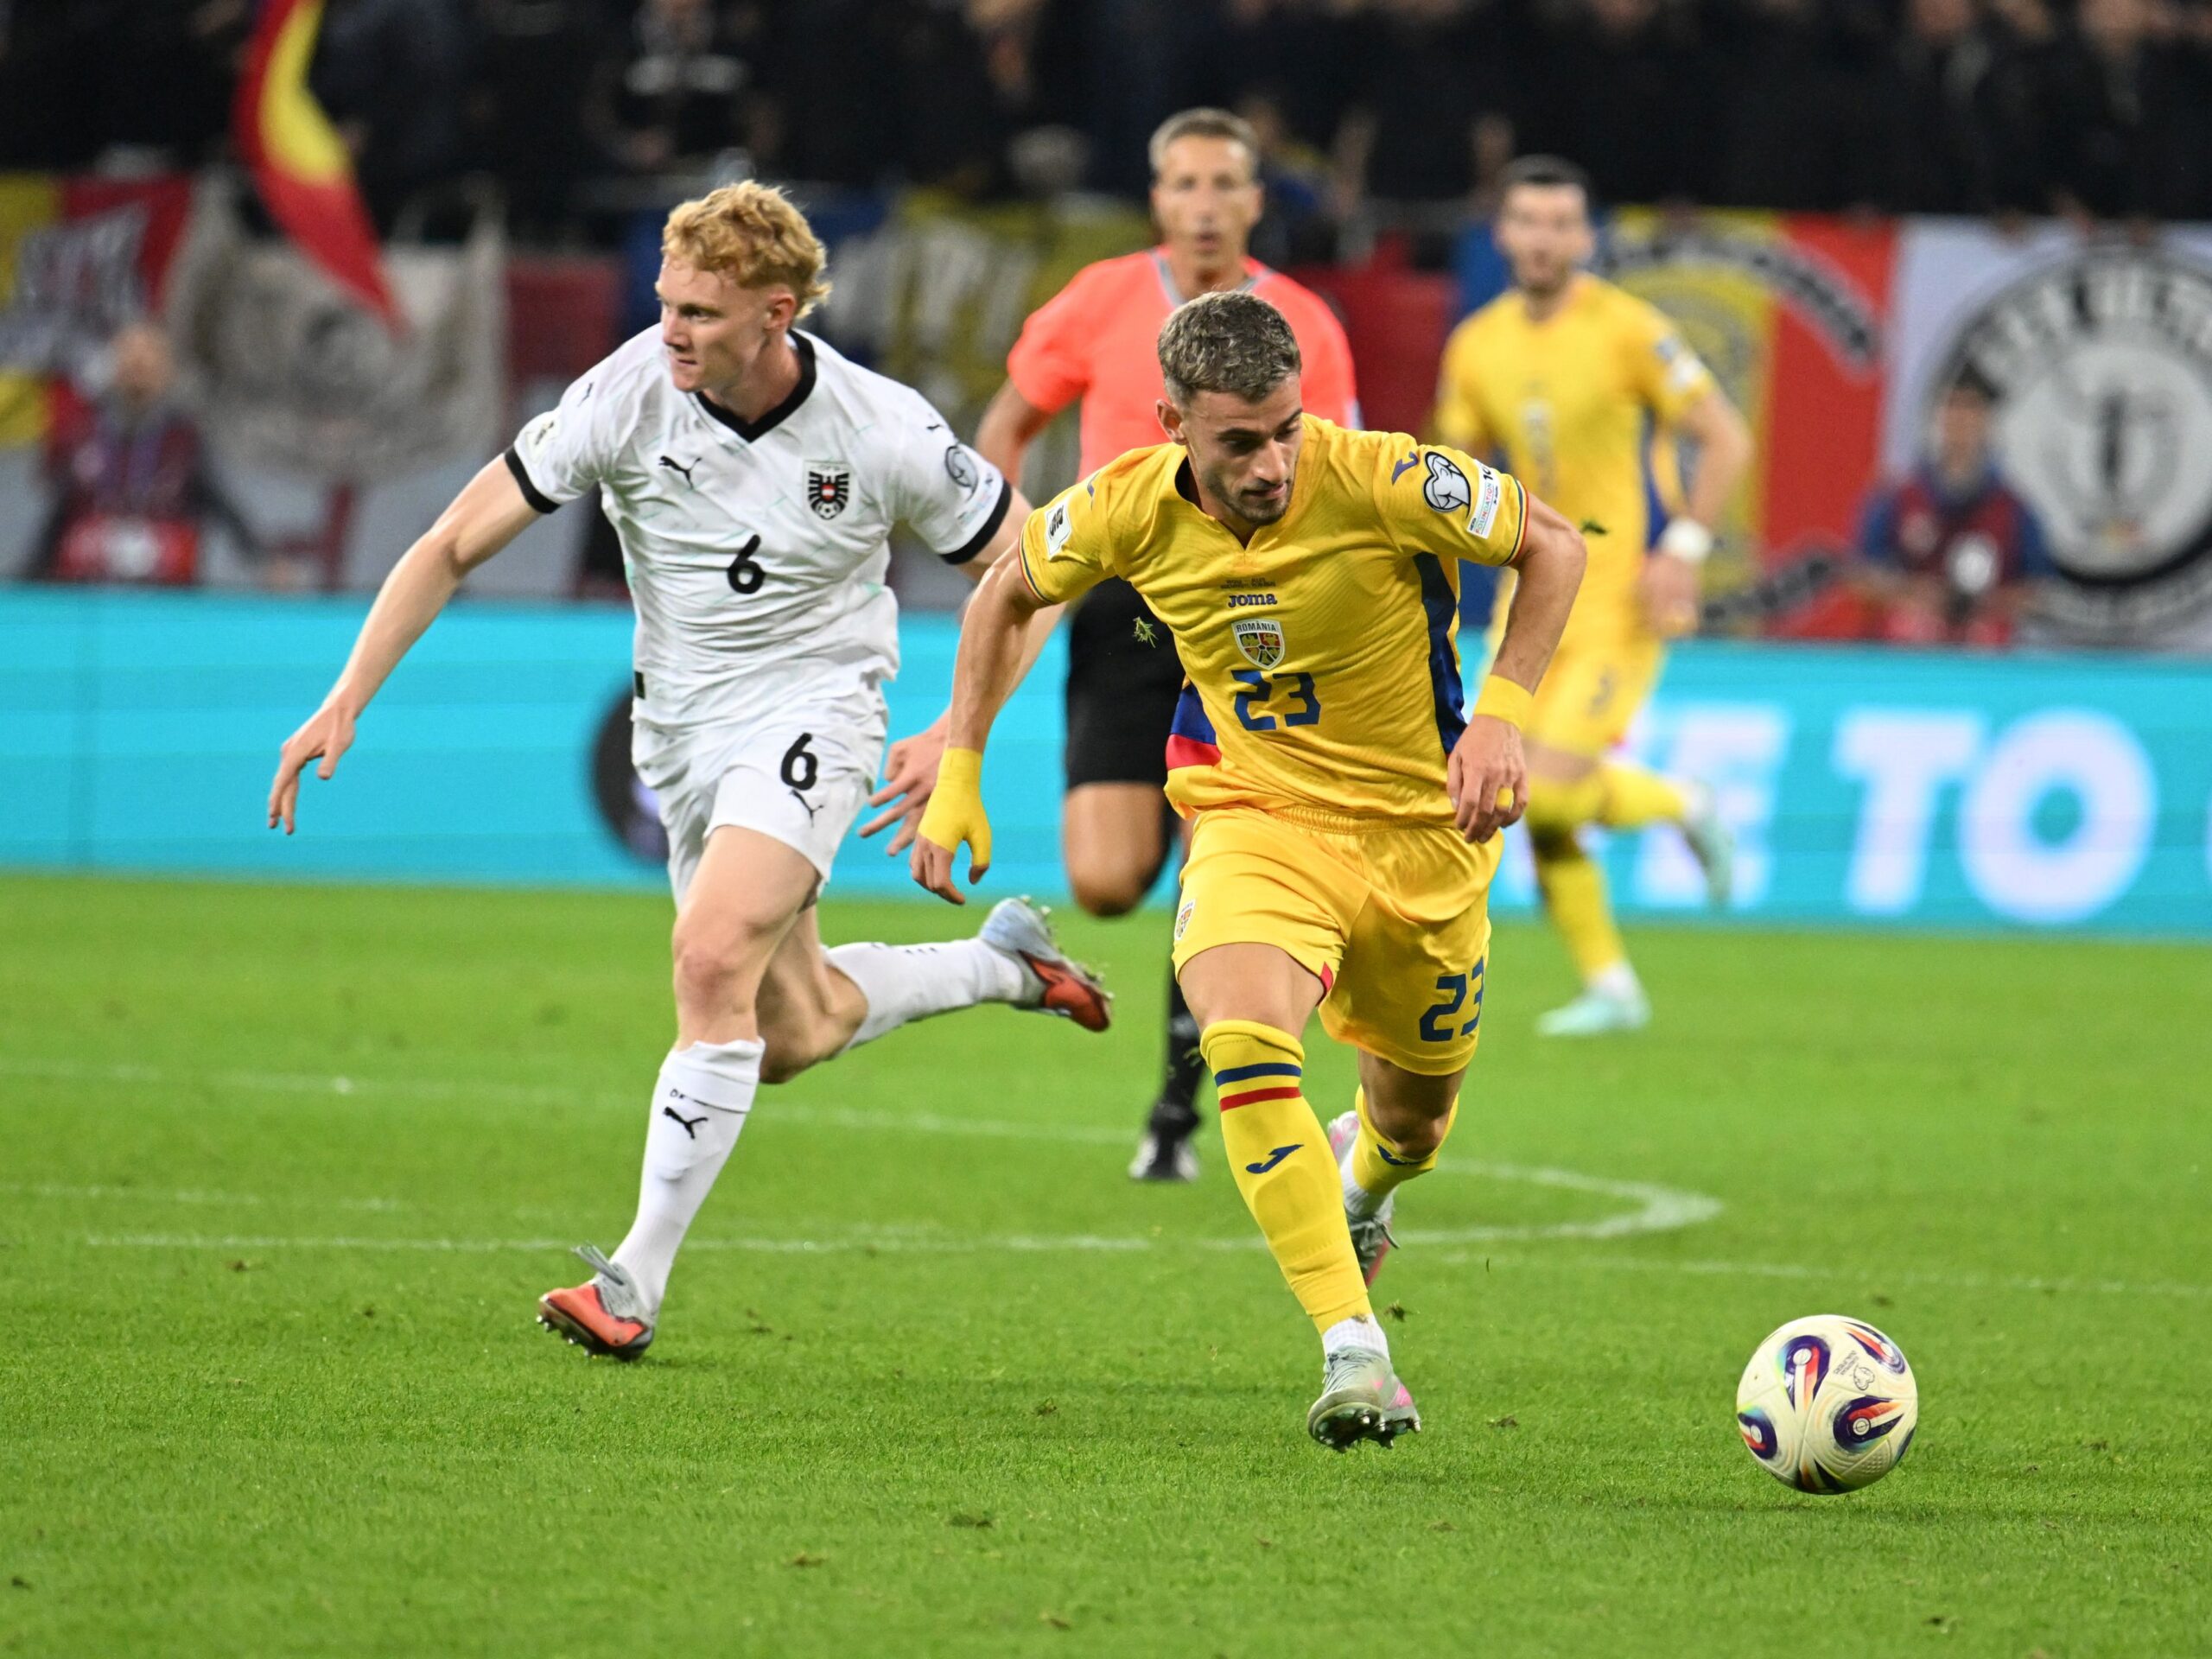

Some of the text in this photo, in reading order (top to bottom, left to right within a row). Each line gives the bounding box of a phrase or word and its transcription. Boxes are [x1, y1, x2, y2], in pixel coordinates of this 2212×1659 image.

[1475, 483, 1493, 533] FOUNDATION
[728, 534, 766, 594] 6
[1230, 670, 1321, 732] 23
[780, 733, 818, 791] 6
[1835, 707, 2155, 923] TO
[1419, 956, 1484, 1042] 23
